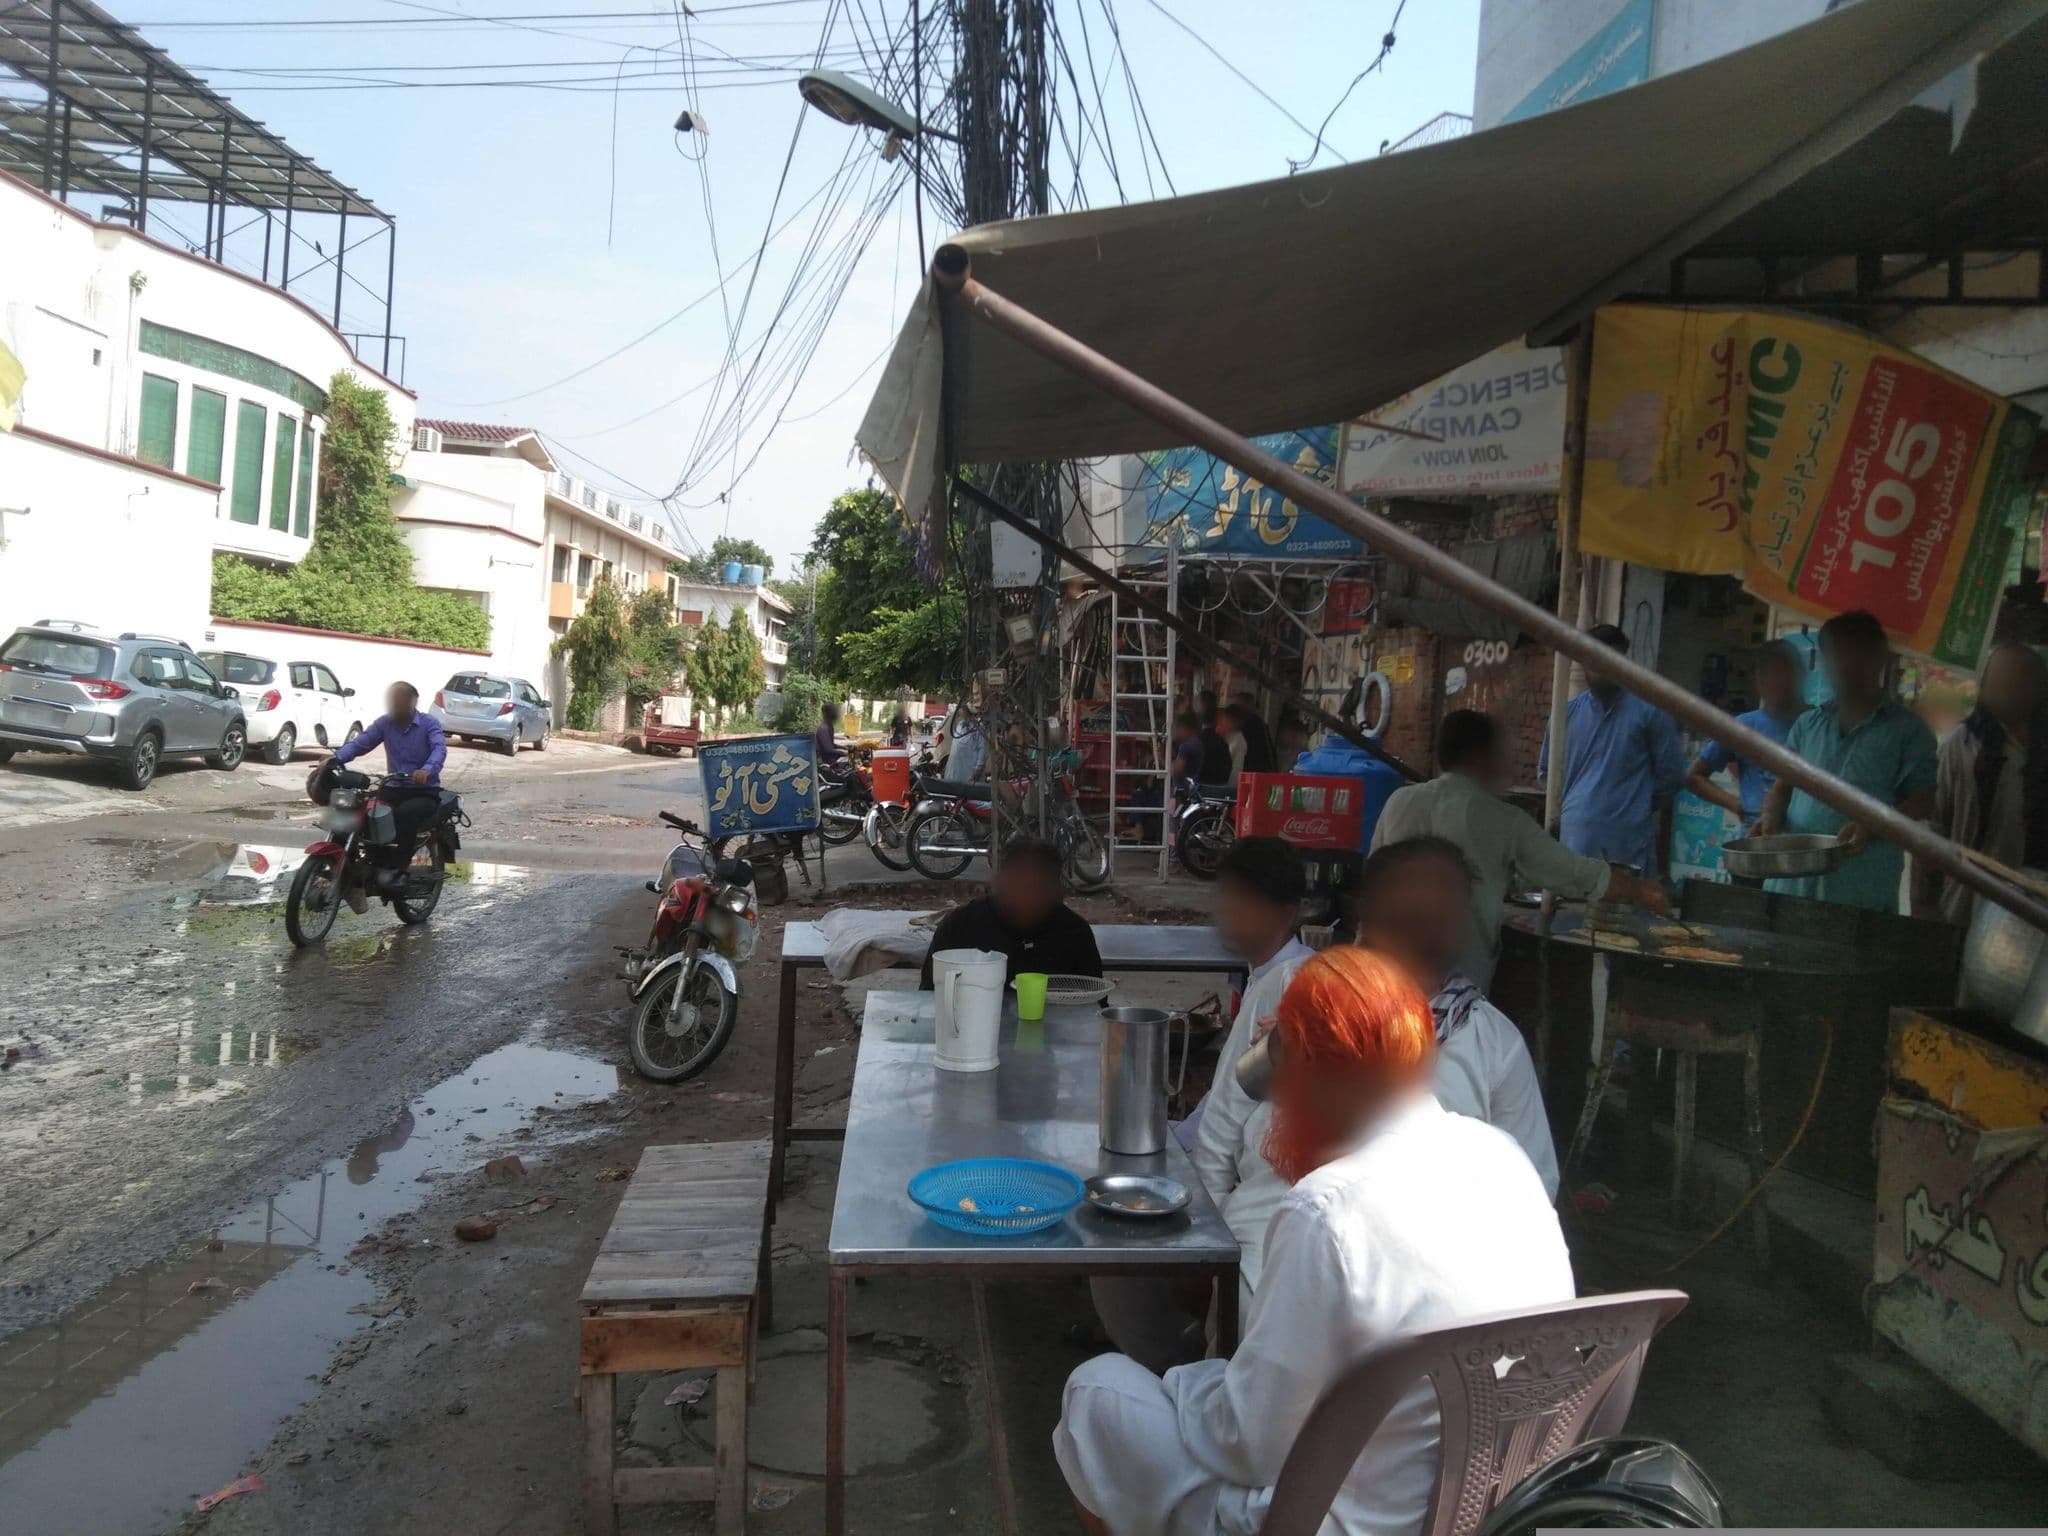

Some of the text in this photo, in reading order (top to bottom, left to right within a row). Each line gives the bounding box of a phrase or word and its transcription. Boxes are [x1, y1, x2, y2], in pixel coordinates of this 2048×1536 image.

[1708, 336, 1743, 416] عید
[1849, 417, 1940, 575] 105
[1758, 510, 1793, 571] تیار
[1463, 640, 1509, 668] 0300
[710, 744, 812, 815] چشتی آٹو
